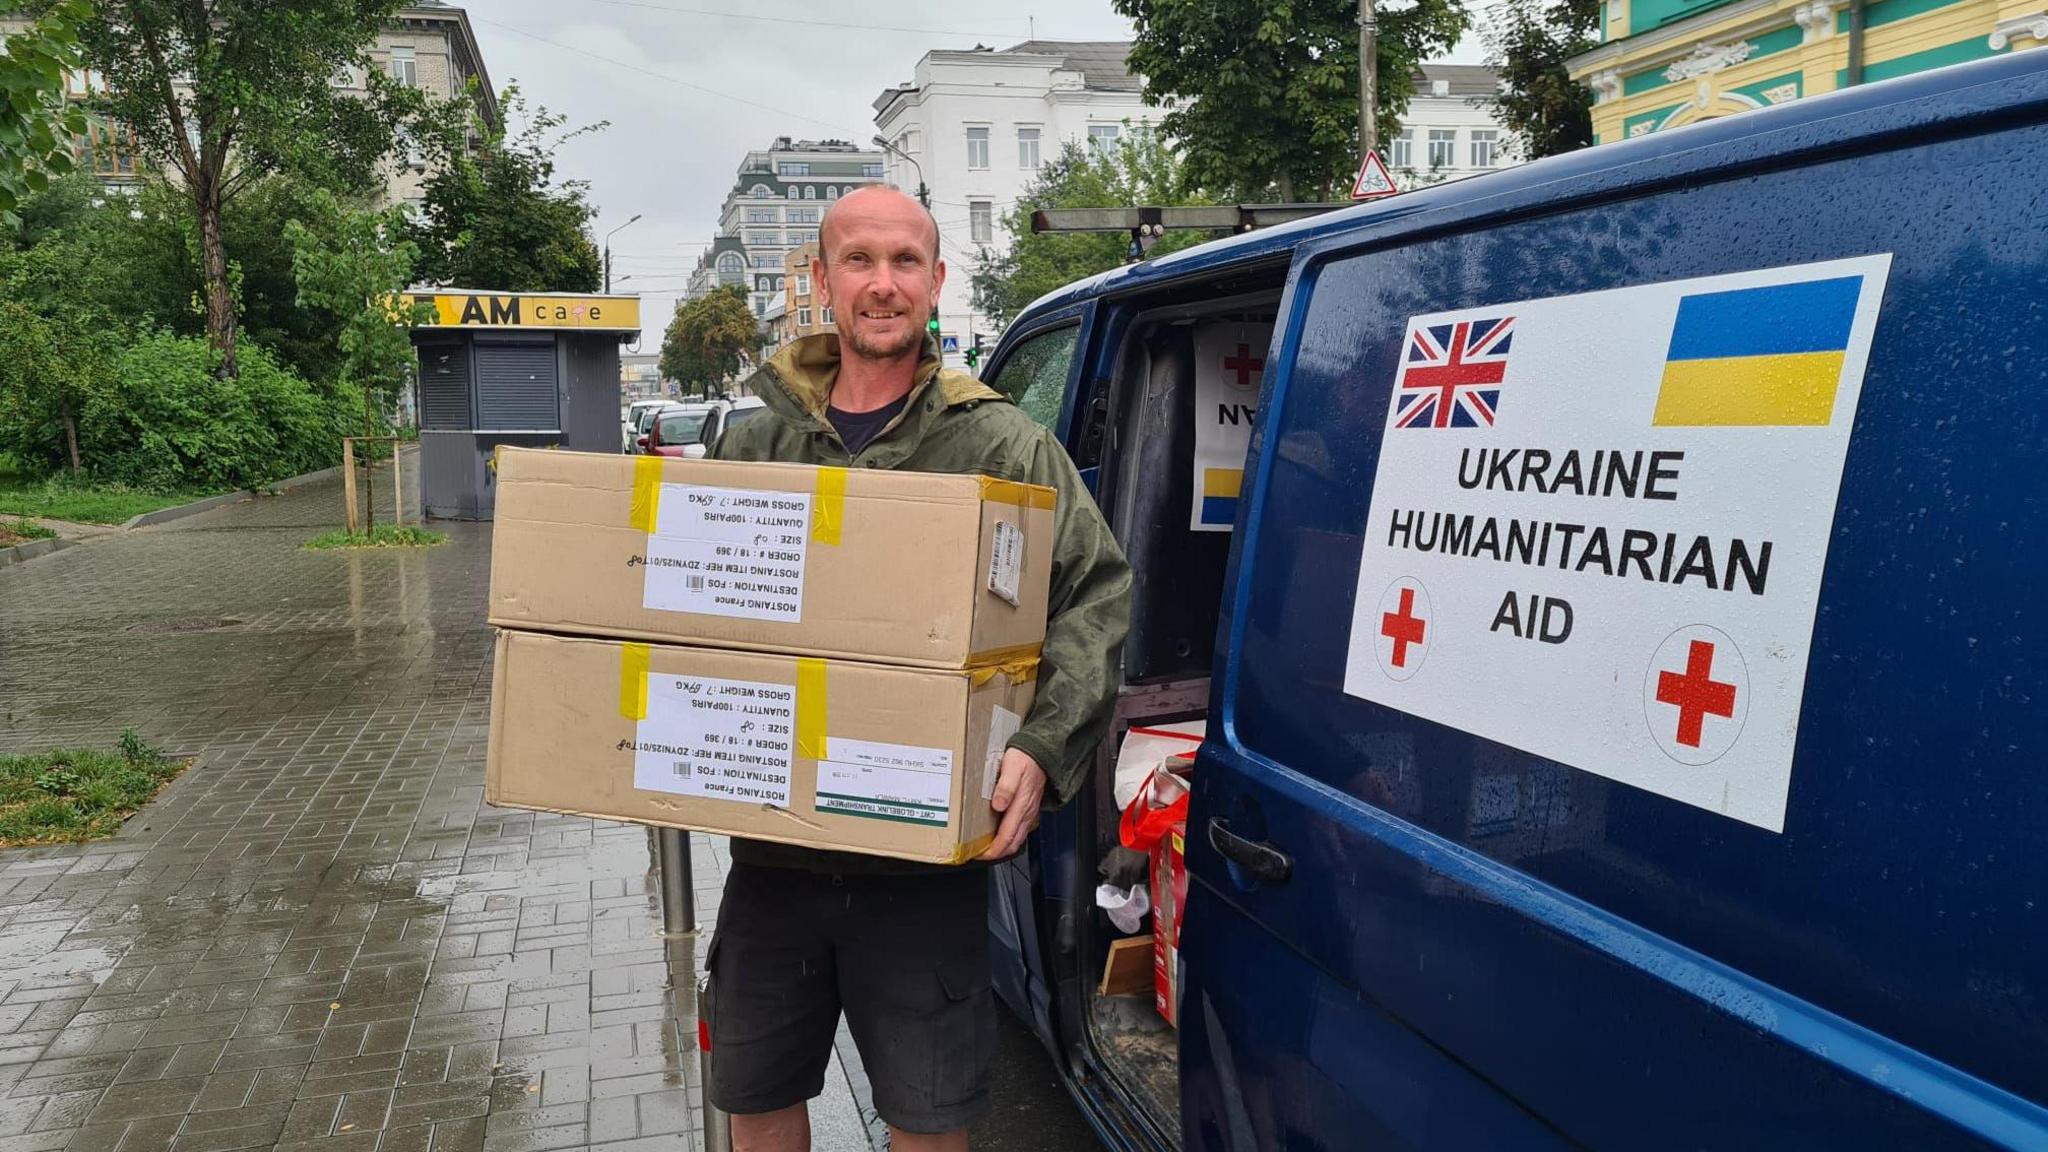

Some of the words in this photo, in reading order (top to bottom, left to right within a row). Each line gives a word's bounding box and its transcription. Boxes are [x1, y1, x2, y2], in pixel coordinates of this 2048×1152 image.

[535, 303, 602, 322] cae
[1457, 447, 1685, 503] UKRAINE
[733, 497, 768, 508] WEIGHT
[772, 500, 804, 511] GROSS
[704, 512, 746, 523] 100PAIRS
[756, 516, 803, 528] QUANTITY
[781, 535, 802, 545] SIZE
[716, 546, 731, 556] 369
[740, 548, 750, 557] 18
[768, 551, 800, 562] ORDER
[1387, 509, 1773, 597] HUMANITARIAN
[702, 562, 723, 571] REF:
[725, 564, 747, 573] ITEM
[750, 566, 799, 578] ROSTAING
[708, 579, 726, 589] FOS
[734, 581, 797, 595] DESTINATION
[715, 596, 745, 608] France
[748, 599, 797, 612] ROSTAING
[1490, 591, 1575, 645] AID
[719, 686, 755, 697] WEIGHT
[758, 690, 790, 701] GROSS
[692, 699, 733, 711] 100PAIRS
[742, 705, 790, 717] QUANTITY
[768, 724, 789, 734] SIZE
[704, 733, 719, 743] 369
[728, 736, 738, 745] 18
[756, 740, 788, 751] ORDER
[692, 749, 711, 758] REF:
[714, 752, 736, 762] ITEM
[739, 754, 787, 767] ROSTAING
[697, 766, 715, 776] FOS
[724, 769, 786, 784] DESTINATION
[704, 783, 734, 795] France
[737, 787, 785, 801] ROSTAING
[826, 800, 876, 811] TRANSHIPMENT
[877, 806, 915, 817] GLOBELINK
